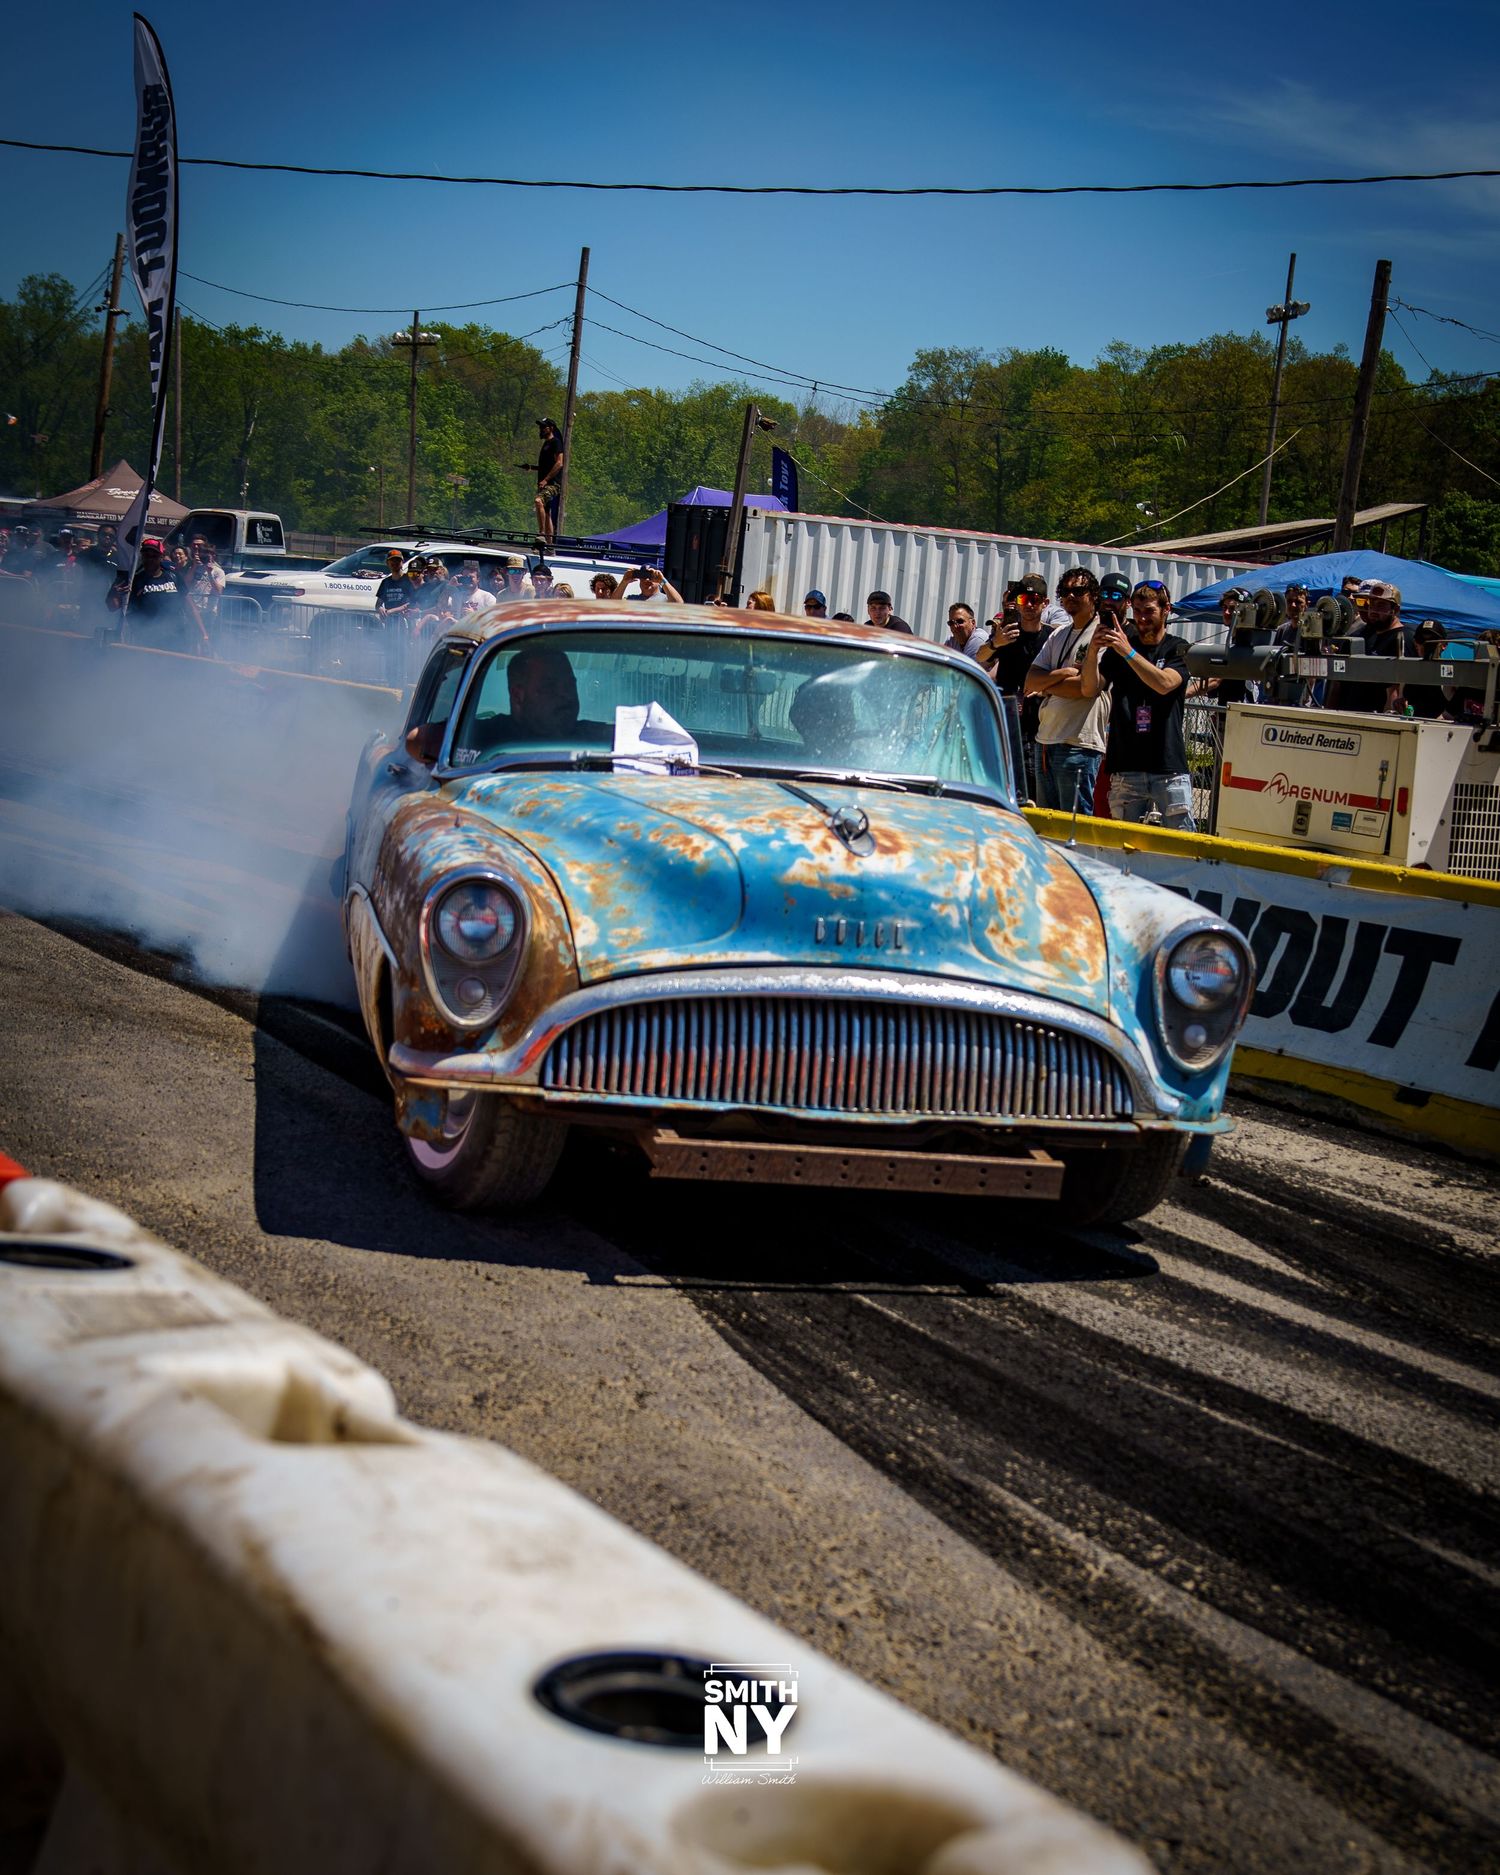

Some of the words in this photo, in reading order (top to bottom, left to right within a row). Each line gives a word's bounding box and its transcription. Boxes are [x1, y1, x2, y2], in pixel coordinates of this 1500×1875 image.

[1280, 730, 1316, 746] United
[1315, 734, 1355, 751] Rentals
[1264, 773, 1349, 806] MAGNUM
[1159, 883, 1462, 1049] OUT
